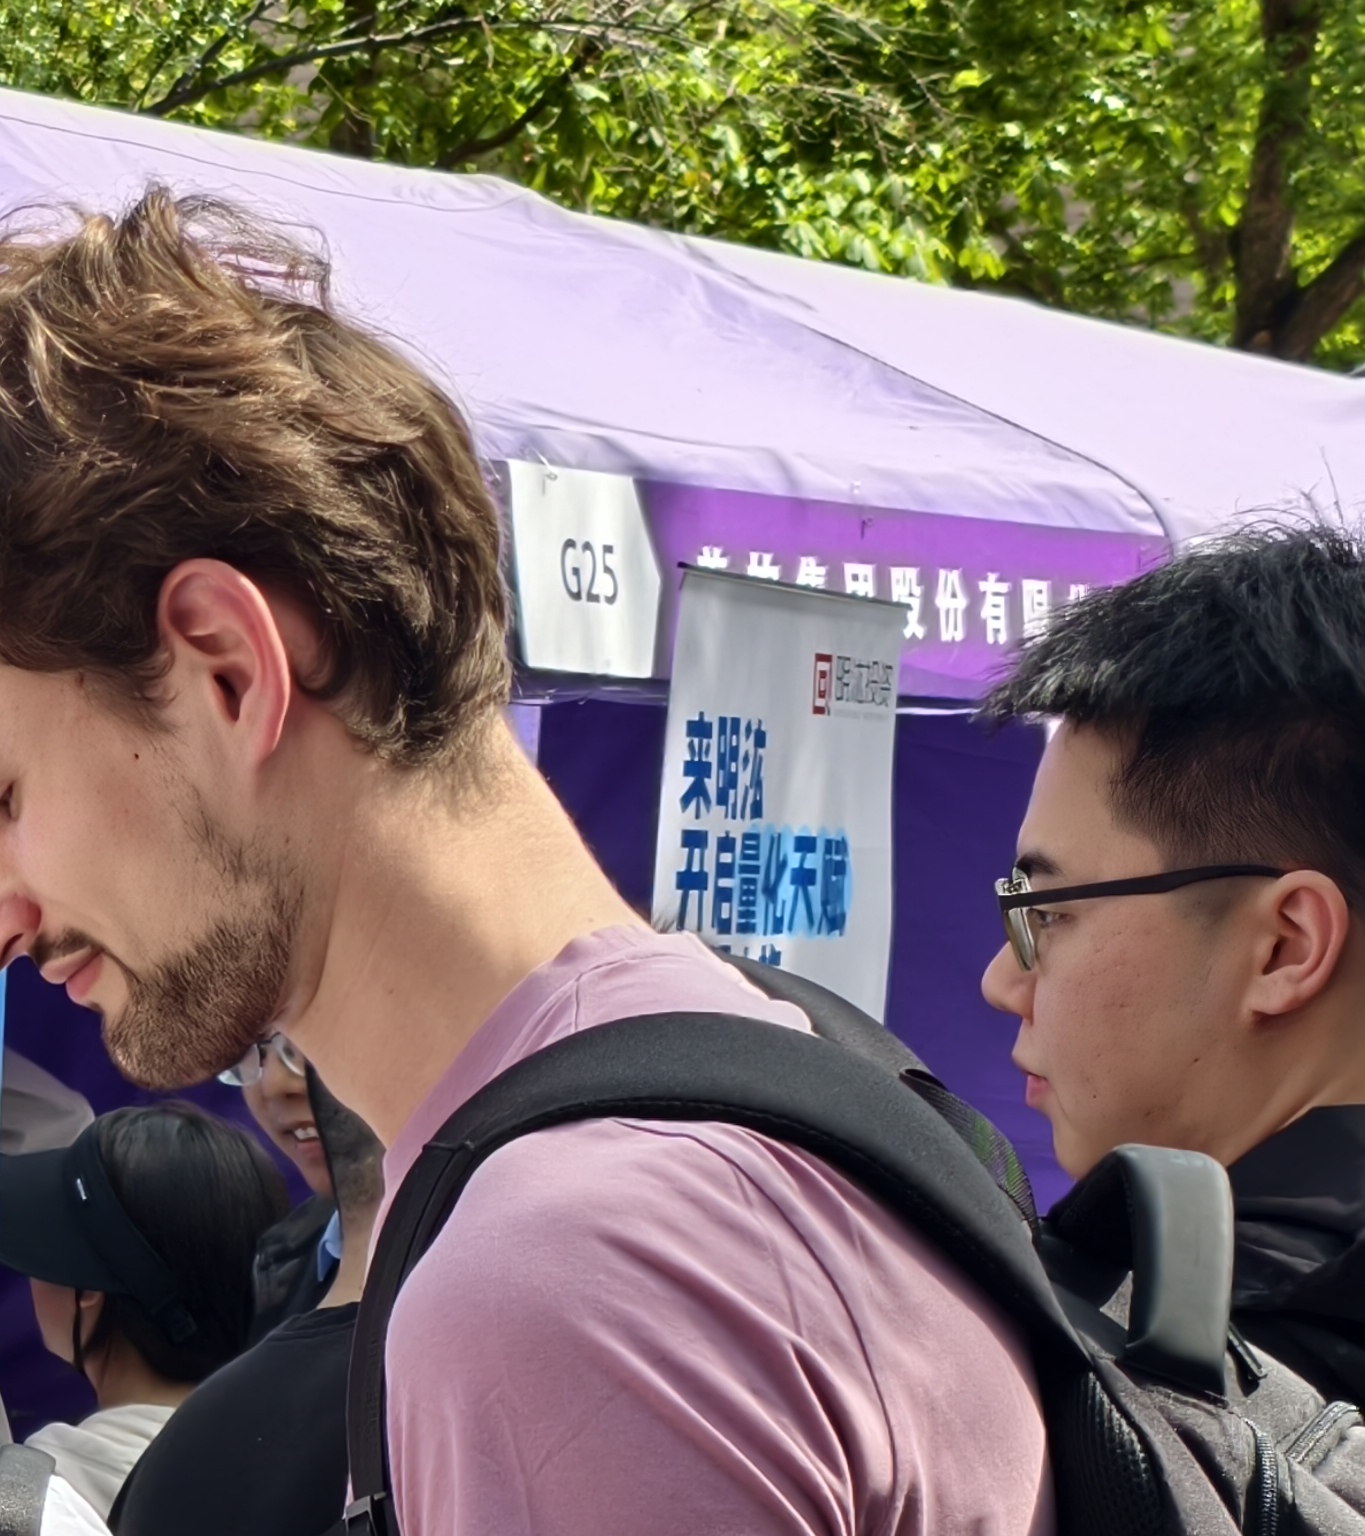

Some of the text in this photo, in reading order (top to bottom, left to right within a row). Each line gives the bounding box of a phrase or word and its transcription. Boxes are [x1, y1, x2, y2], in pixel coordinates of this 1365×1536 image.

[560, 538, 619, 606] G25
[676, 829, 849, 937] 开启量化天赋
